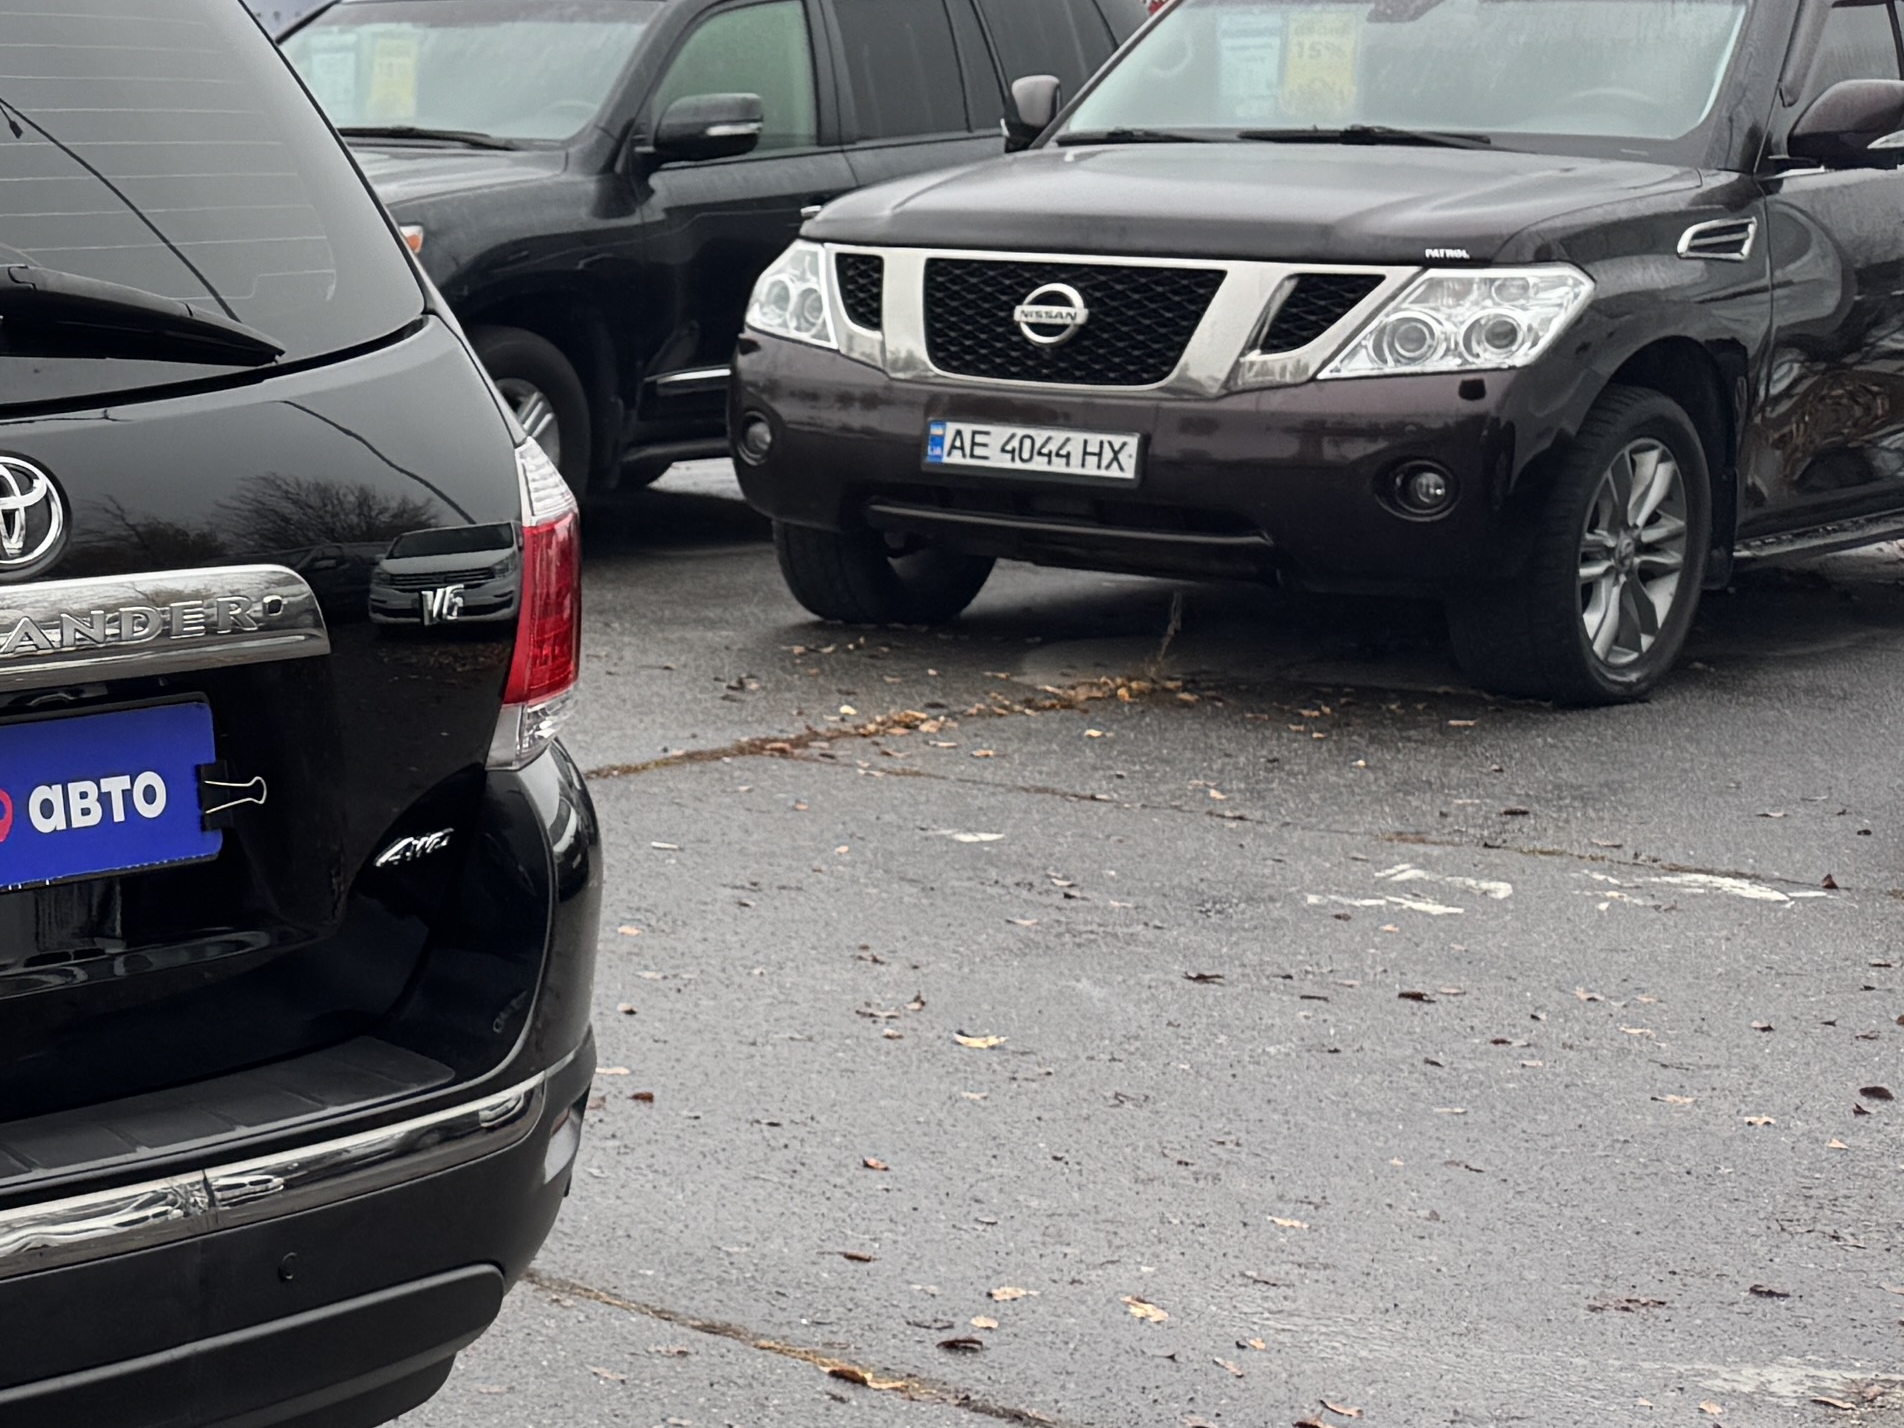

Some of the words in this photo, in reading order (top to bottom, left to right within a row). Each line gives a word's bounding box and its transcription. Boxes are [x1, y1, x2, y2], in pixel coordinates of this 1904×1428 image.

[1020, 309, 1078, 322] NISSAN
[946, 428, 991, 460] AE
[1000, 432, 1072, 468] 4044
[1080, 438, 1128, 473] HX
[421, 583, 465, 626] V6
[28, 770, 168, 834] авто
